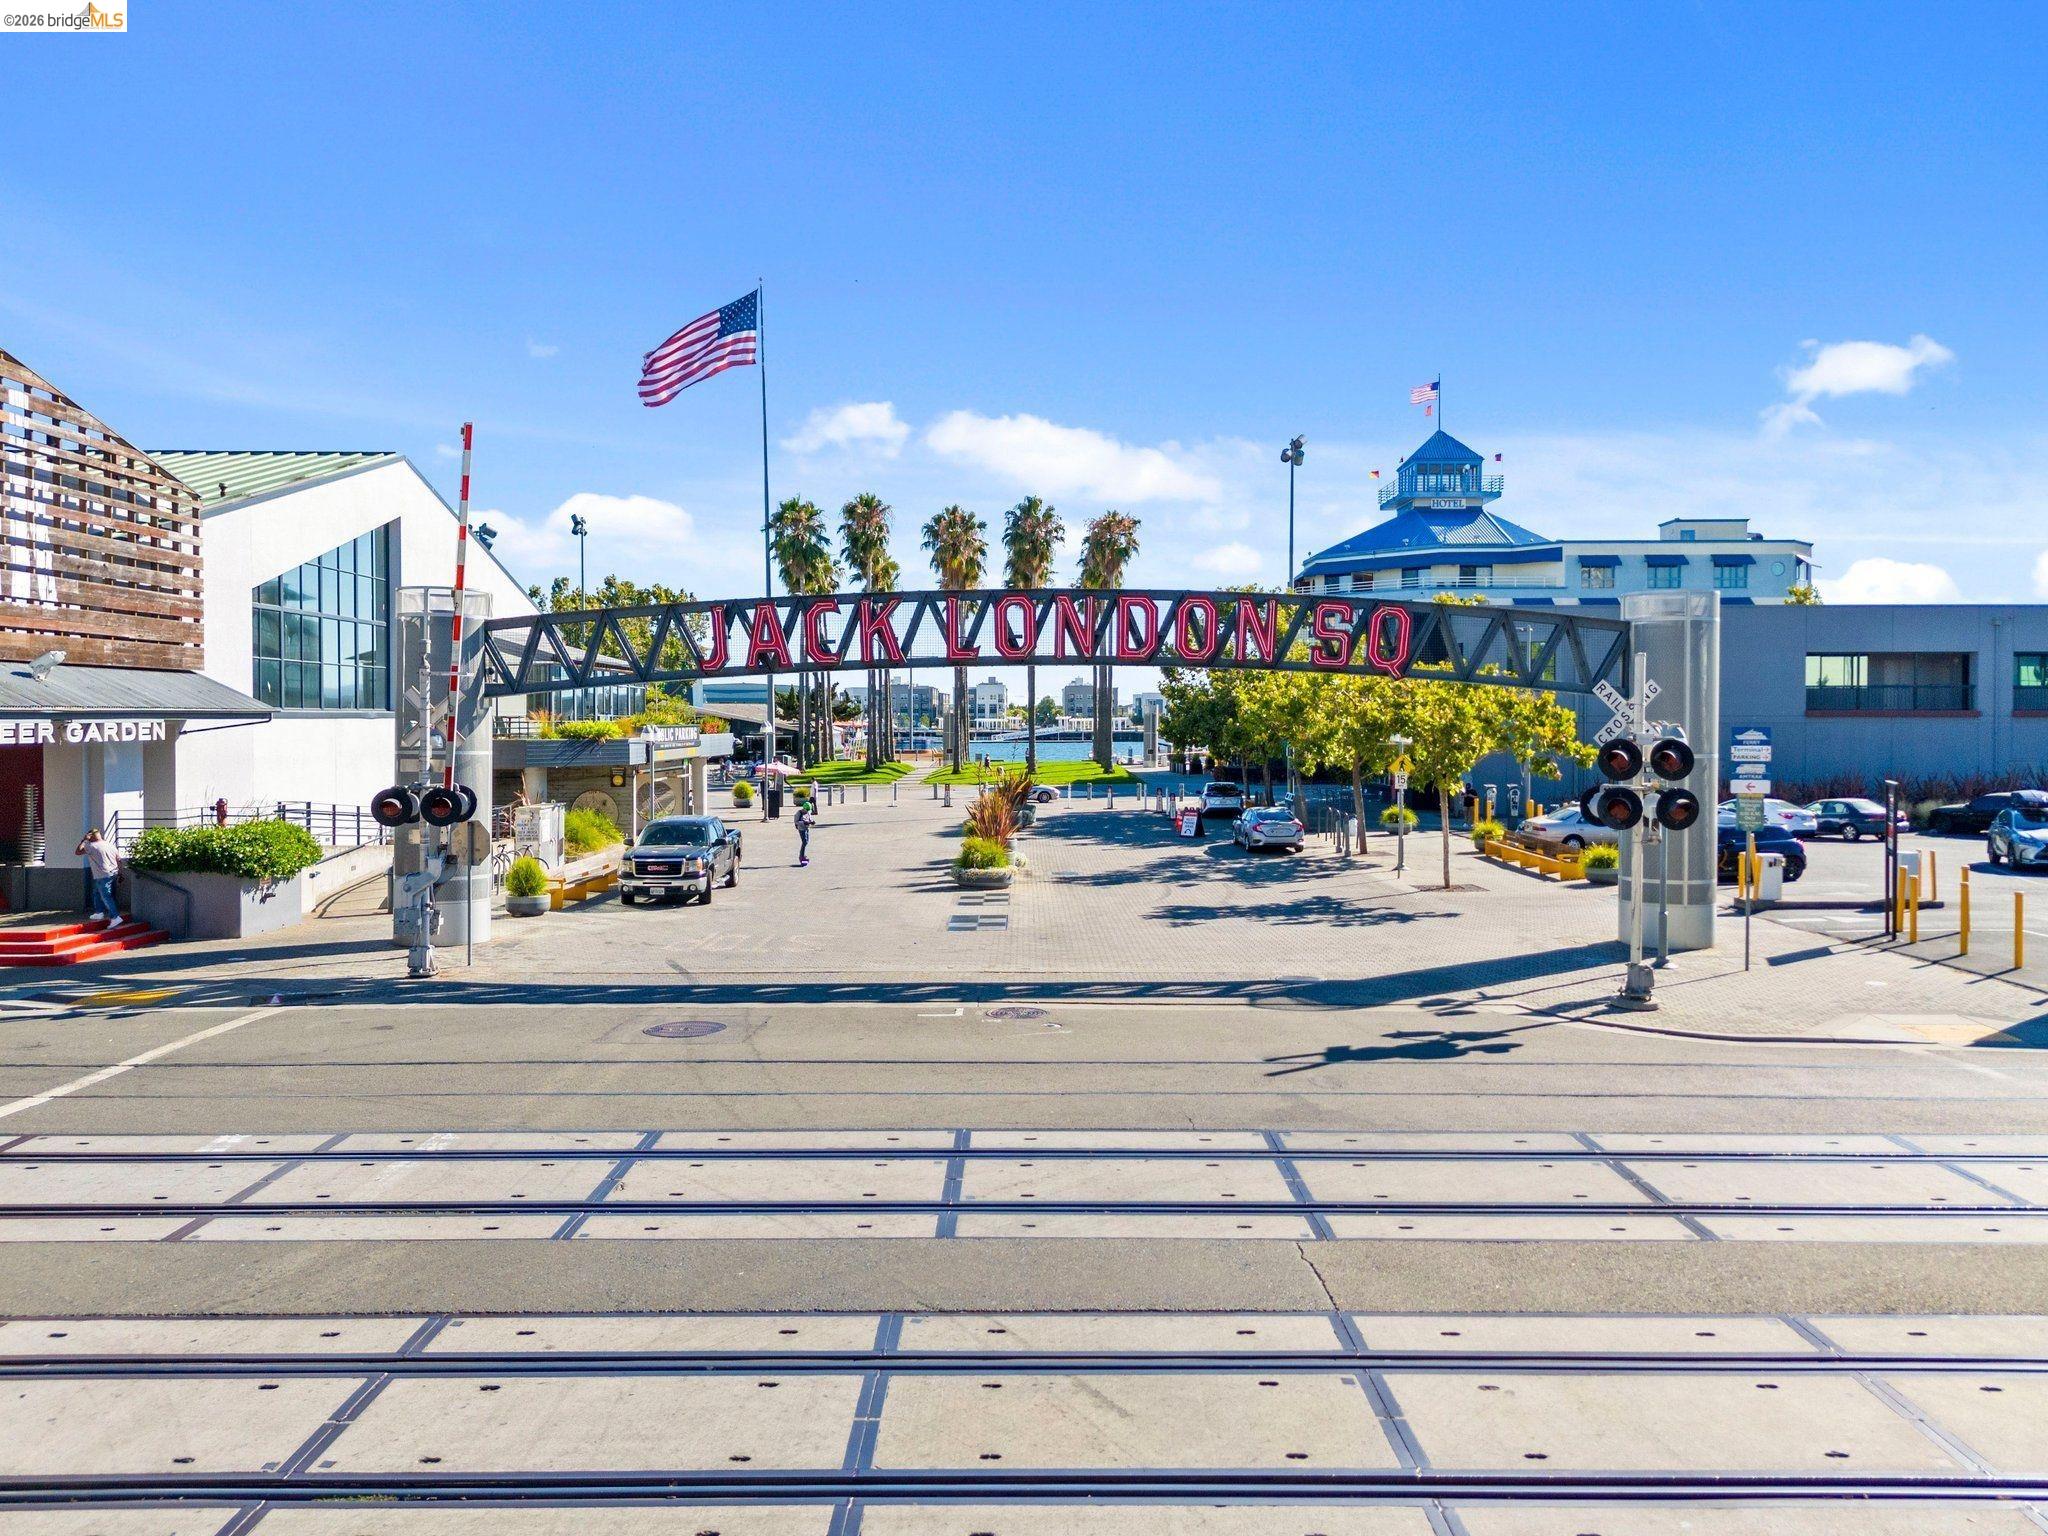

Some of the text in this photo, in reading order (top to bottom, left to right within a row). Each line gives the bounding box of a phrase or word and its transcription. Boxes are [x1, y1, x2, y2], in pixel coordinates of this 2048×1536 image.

[1432, 499, 1465, 508] HOTEL
[699, 593, 1413, 680] JACK LONDON SQ
[66, 721, 166, 743] GARDEN
[675, 726, 698, 741] PARKING
[1396, 775, 1406, 784] 15
